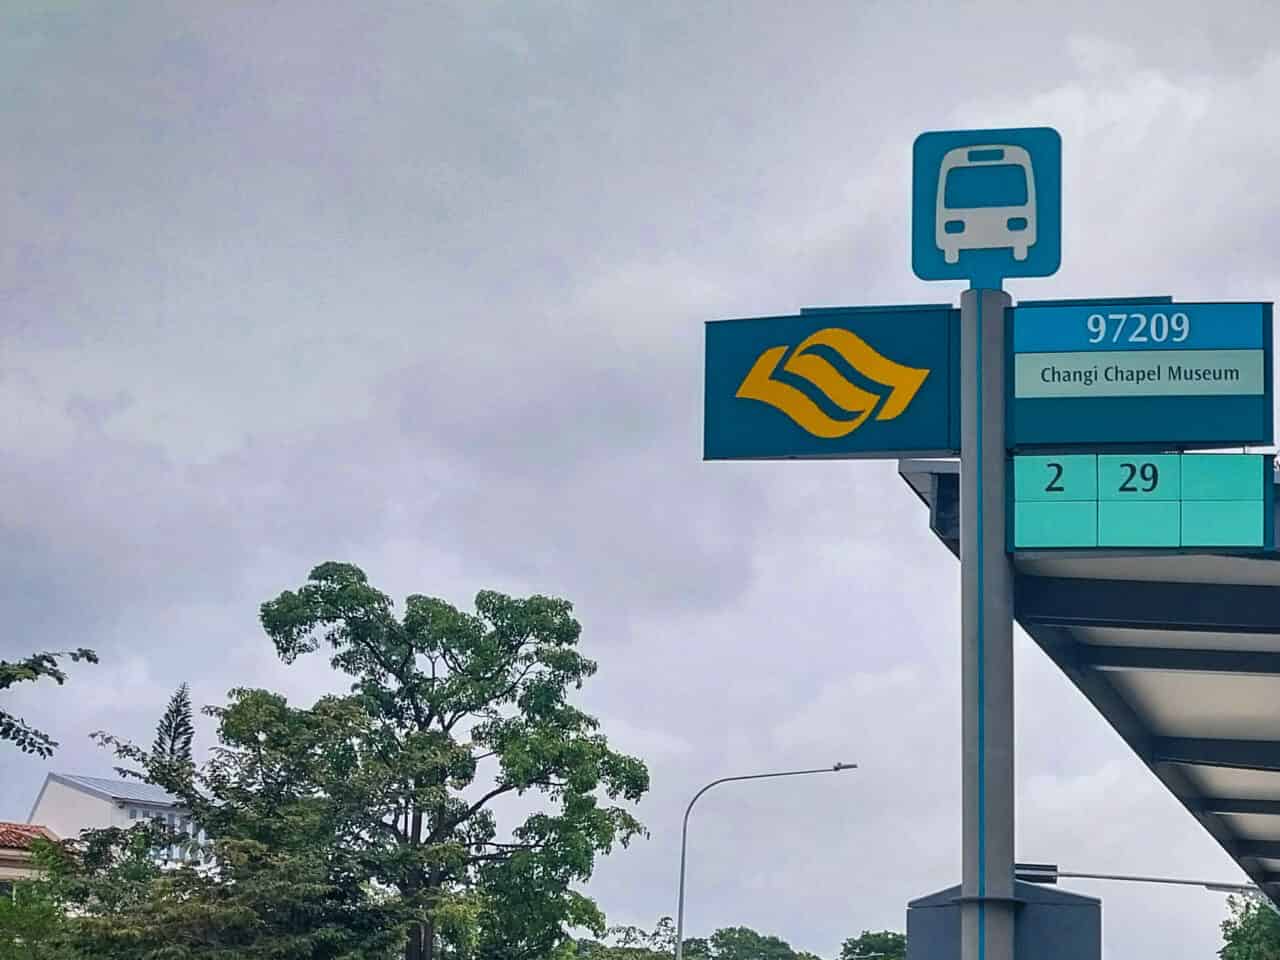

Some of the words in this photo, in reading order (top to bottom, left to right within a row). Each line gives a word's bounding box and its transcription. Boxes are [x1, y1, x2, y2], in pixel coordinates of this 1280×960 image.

[1087, 313, 1190, 343] 97209
[1041, 366, 1097, 386] Changi
[1104, 365, 1161, 385] Chapel
[1168, 365, 1240, 381] Museum
[1044, 462, 1065, 493] 2
[1118, 462, 1159, 493] 29
